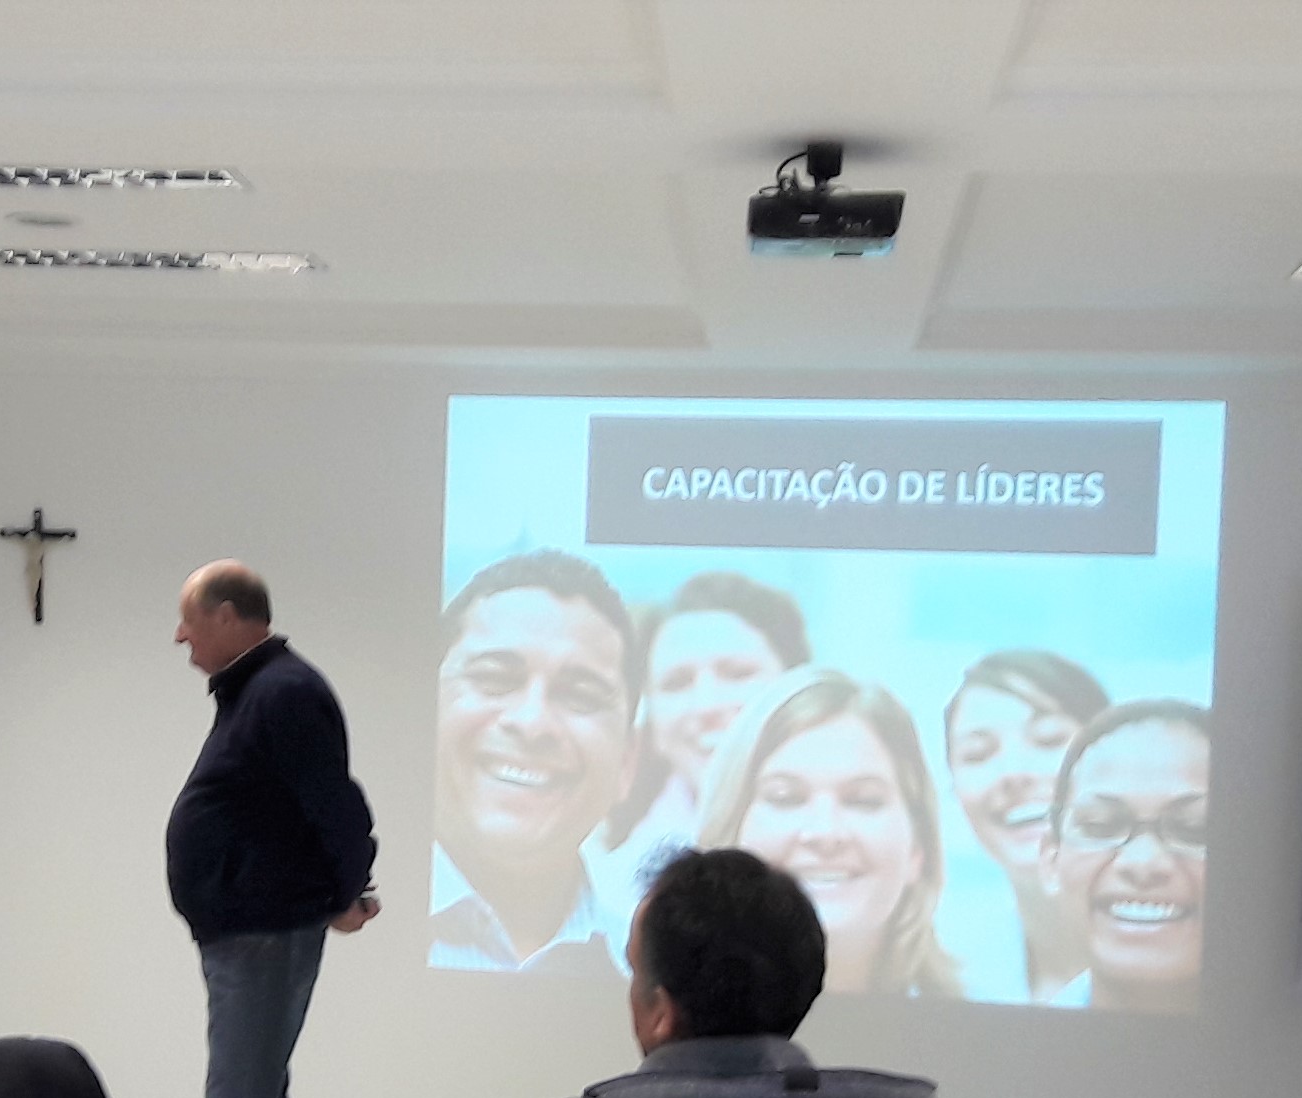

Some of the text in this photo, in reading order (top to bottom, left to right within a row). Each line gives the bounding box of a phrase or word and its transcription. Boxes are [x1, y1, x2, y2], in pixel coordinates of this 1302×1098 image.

[642, 461, 1106, 510] CAPACITAÇÃO DE LÍDERES
